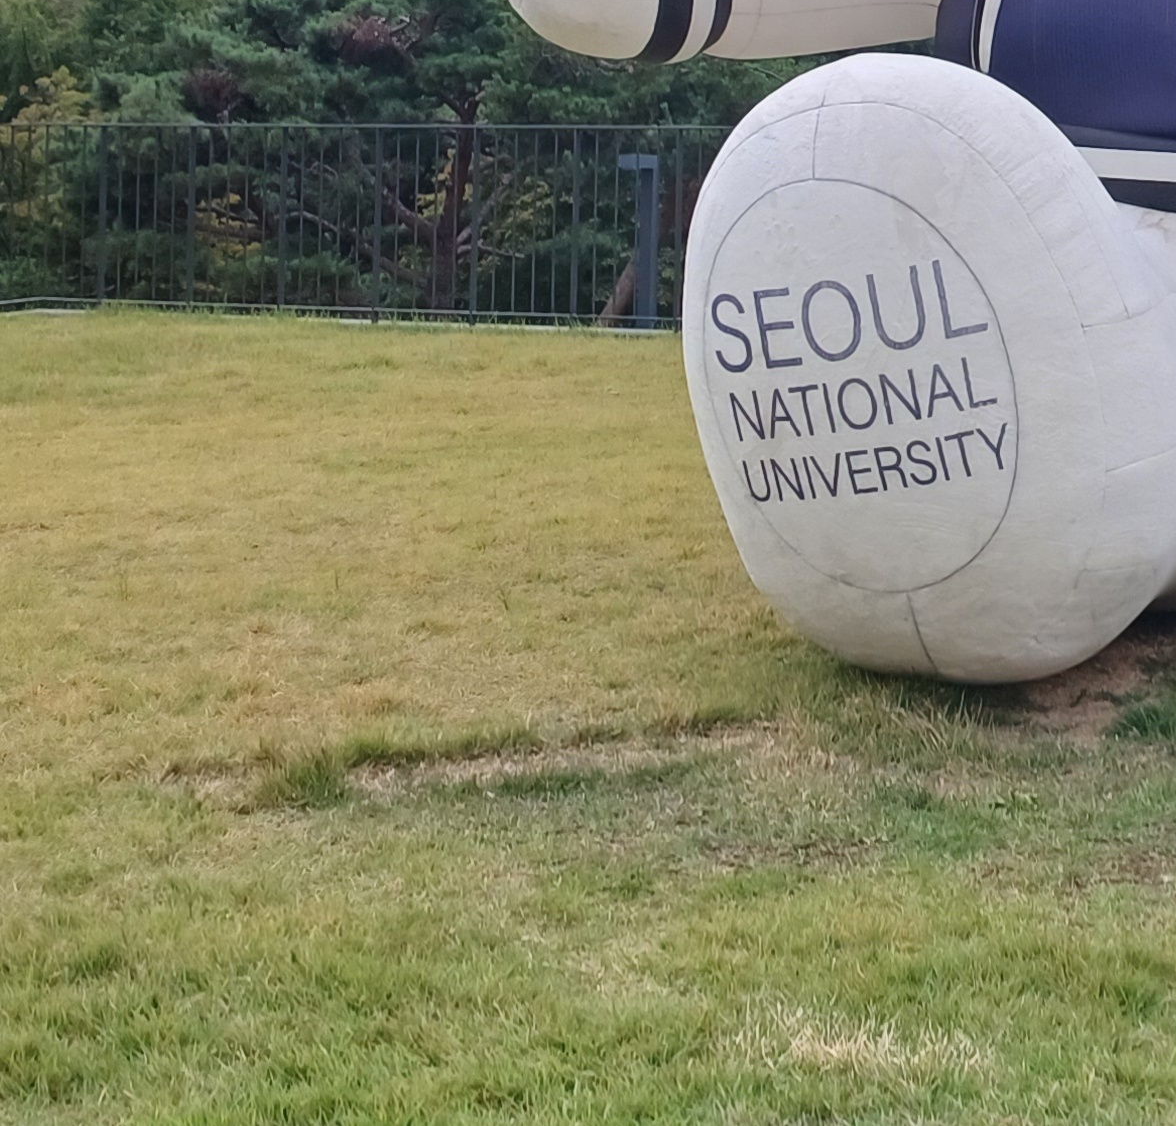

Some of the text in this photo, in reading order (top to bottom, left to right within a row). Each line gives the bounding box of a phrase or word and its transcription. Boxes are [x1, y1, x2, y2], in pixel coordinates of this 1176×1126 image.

[711, 259, 988, 373] SEOUL
[728, 356, 998, 442] NATIONAL
[741, 421, 1008, 502] UNIVERSITY
